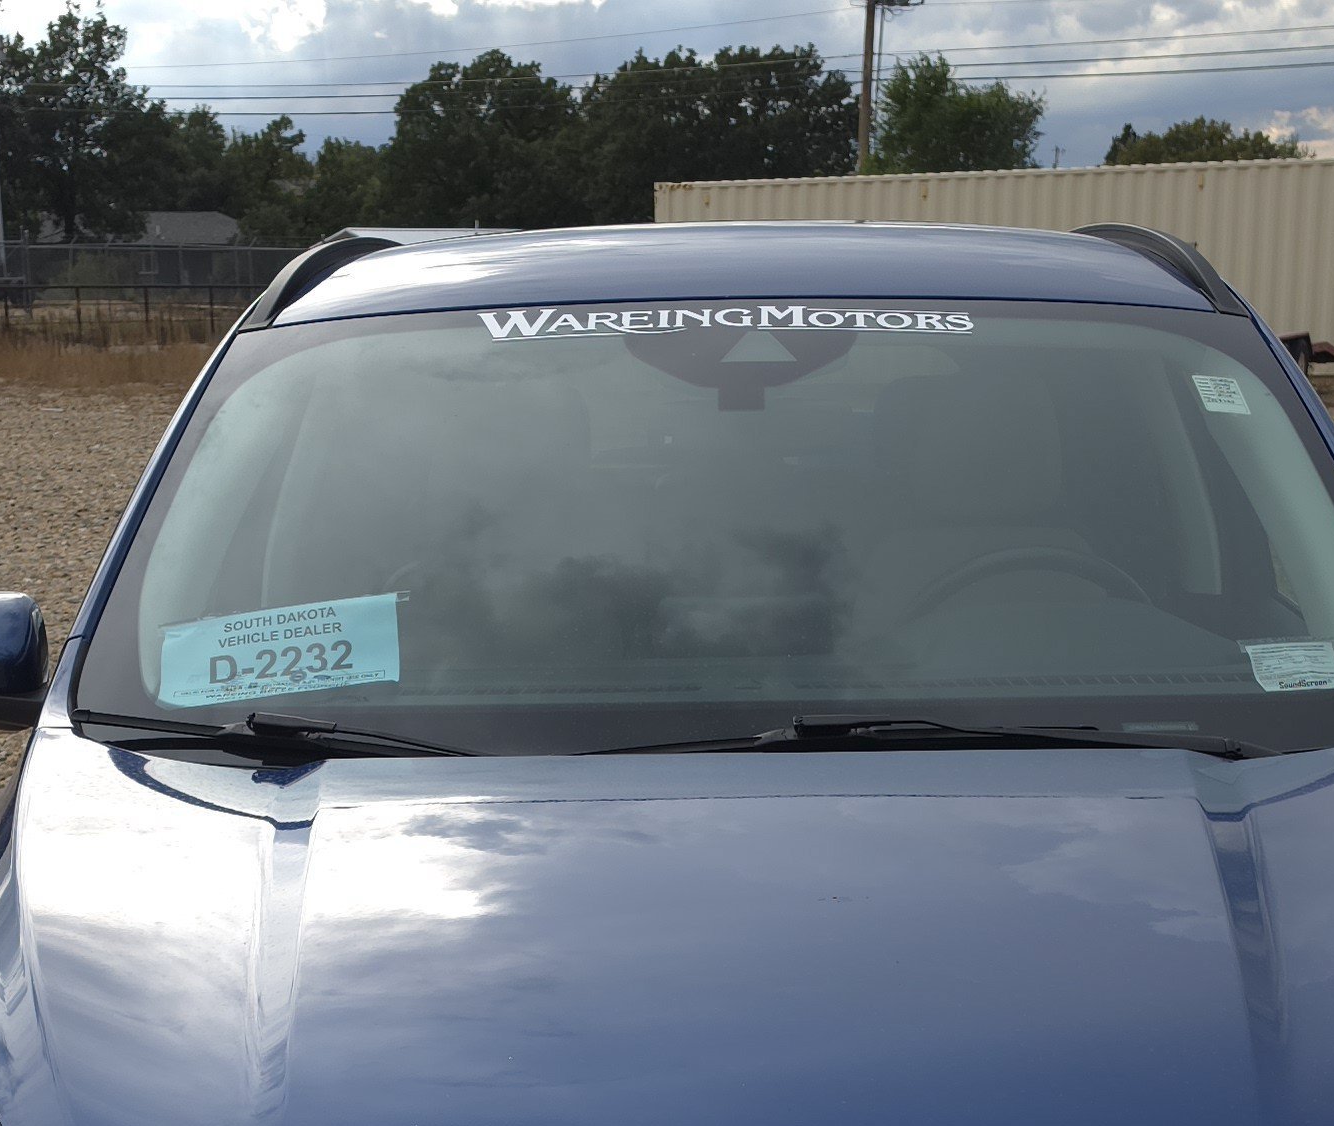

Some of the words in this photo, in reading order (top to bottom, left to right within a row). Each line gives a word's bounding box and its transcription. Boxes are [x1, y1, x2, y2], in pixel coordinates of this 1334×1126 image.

[477, 305, 975, 338] WAREINGMOTORS
[223, 615, 273, 633] SOUTH
[276, 606, 336, 625] DAKOTA
[218, 630, 279, 649] VEHICLE
[283, 622, 342, 640] DEALER
[209, 639, 353, 684] D-2232
